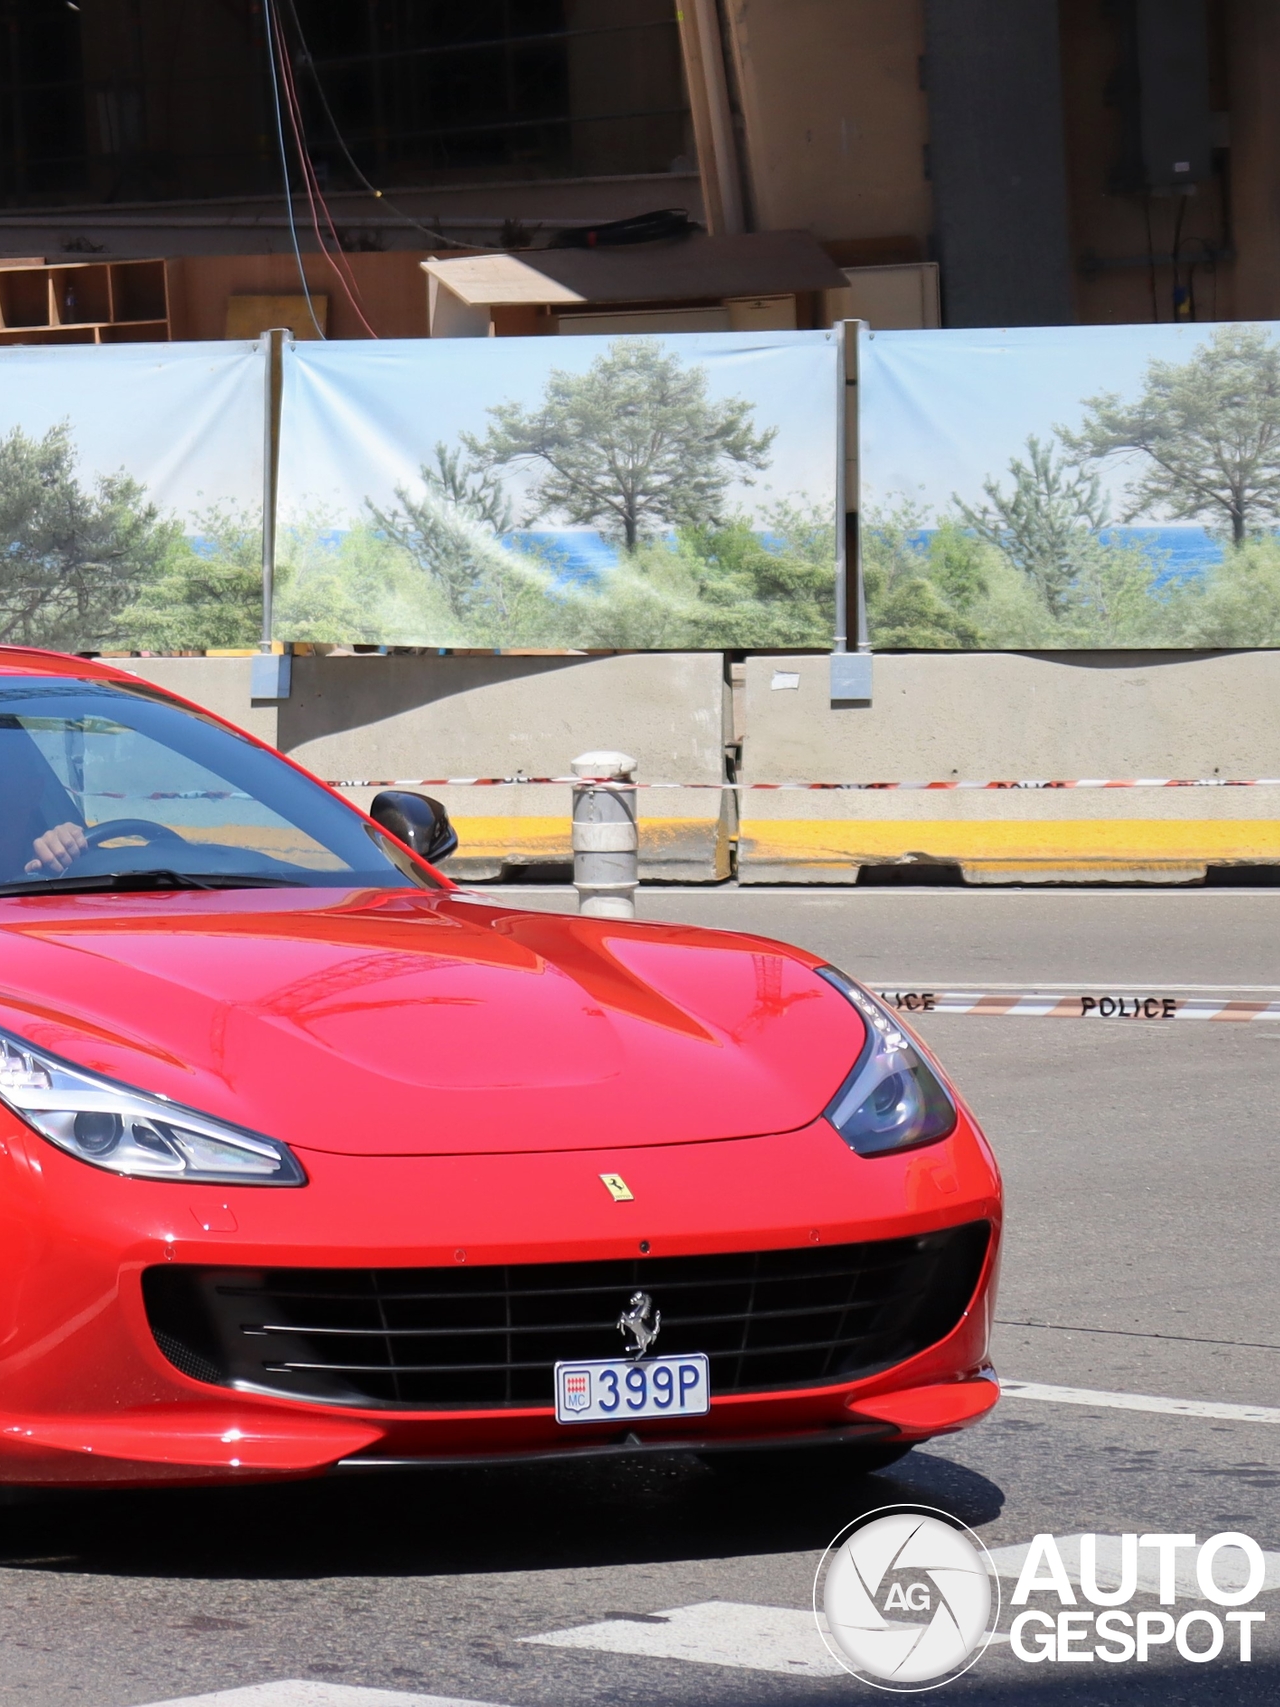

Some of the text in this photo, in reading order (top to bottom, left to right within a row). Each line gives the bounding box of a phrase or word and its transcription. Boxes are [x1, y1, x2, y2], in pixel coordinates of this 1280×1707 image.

[1081, 996, 1177, 1018] POLICE
[599, 1365, 700, 1412] 399P
[569, 1394, 586, 1406] MC
